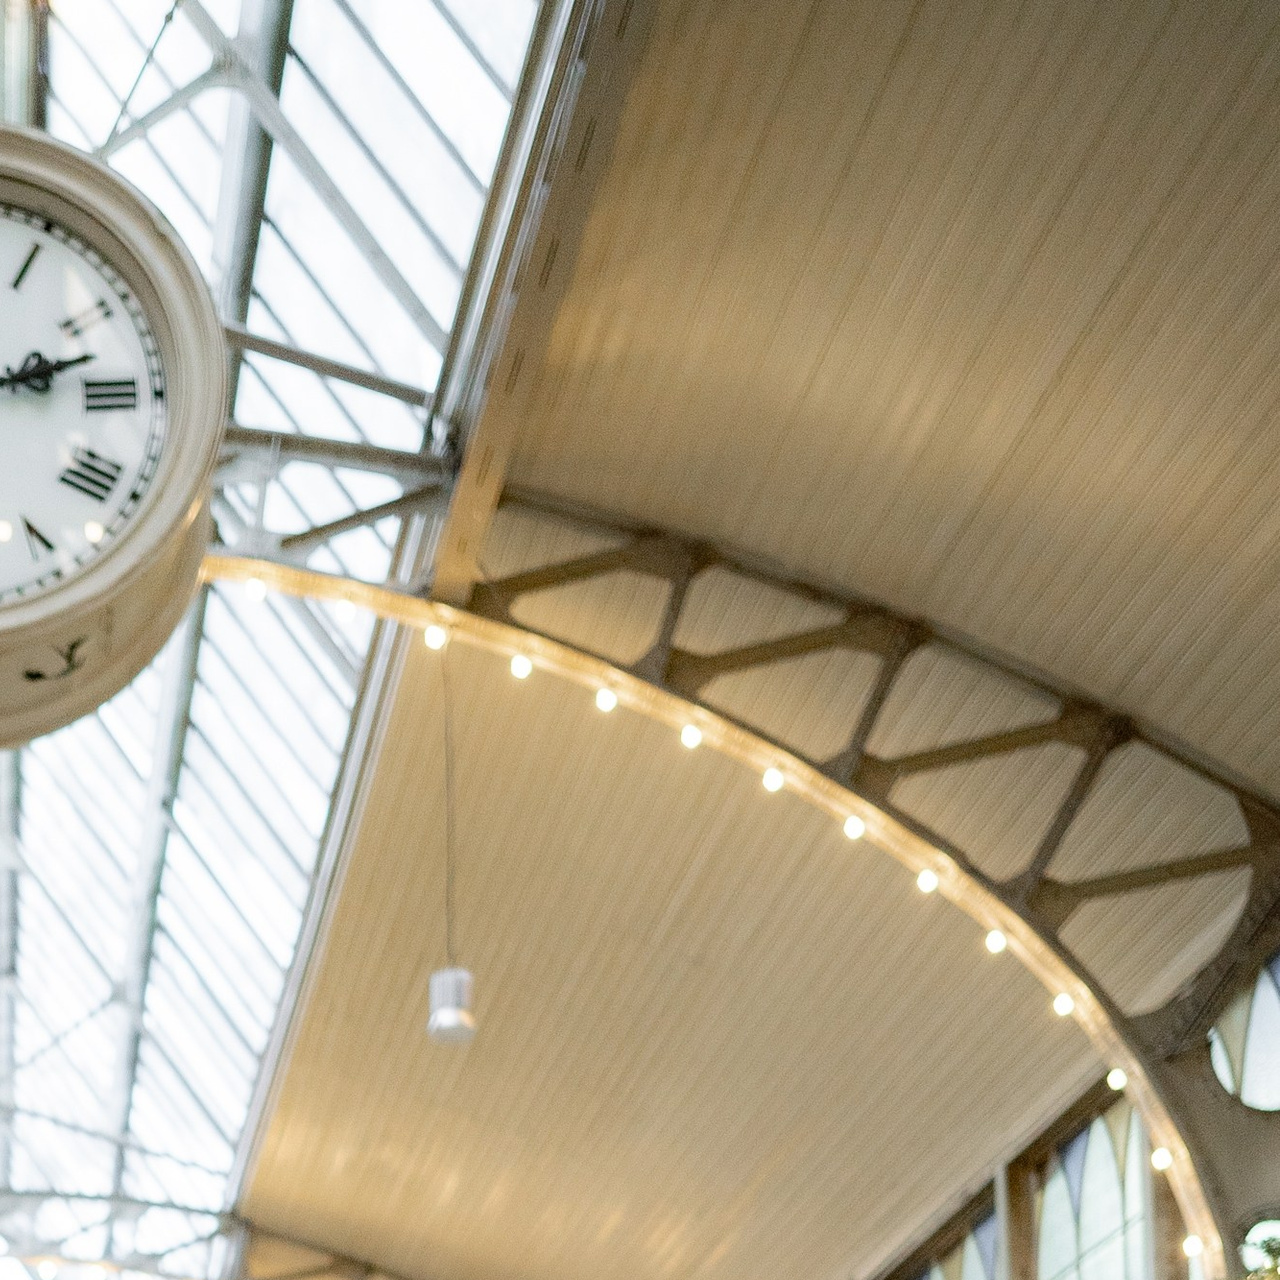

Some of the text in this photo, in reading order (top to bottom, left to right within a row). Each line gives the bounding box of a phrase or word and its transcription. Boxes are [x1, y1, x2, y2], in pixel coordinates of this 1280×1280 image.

[11, 242, 42, 289] I
[83, 377, 136, 412] III
[20, 513, 54, 560] V
